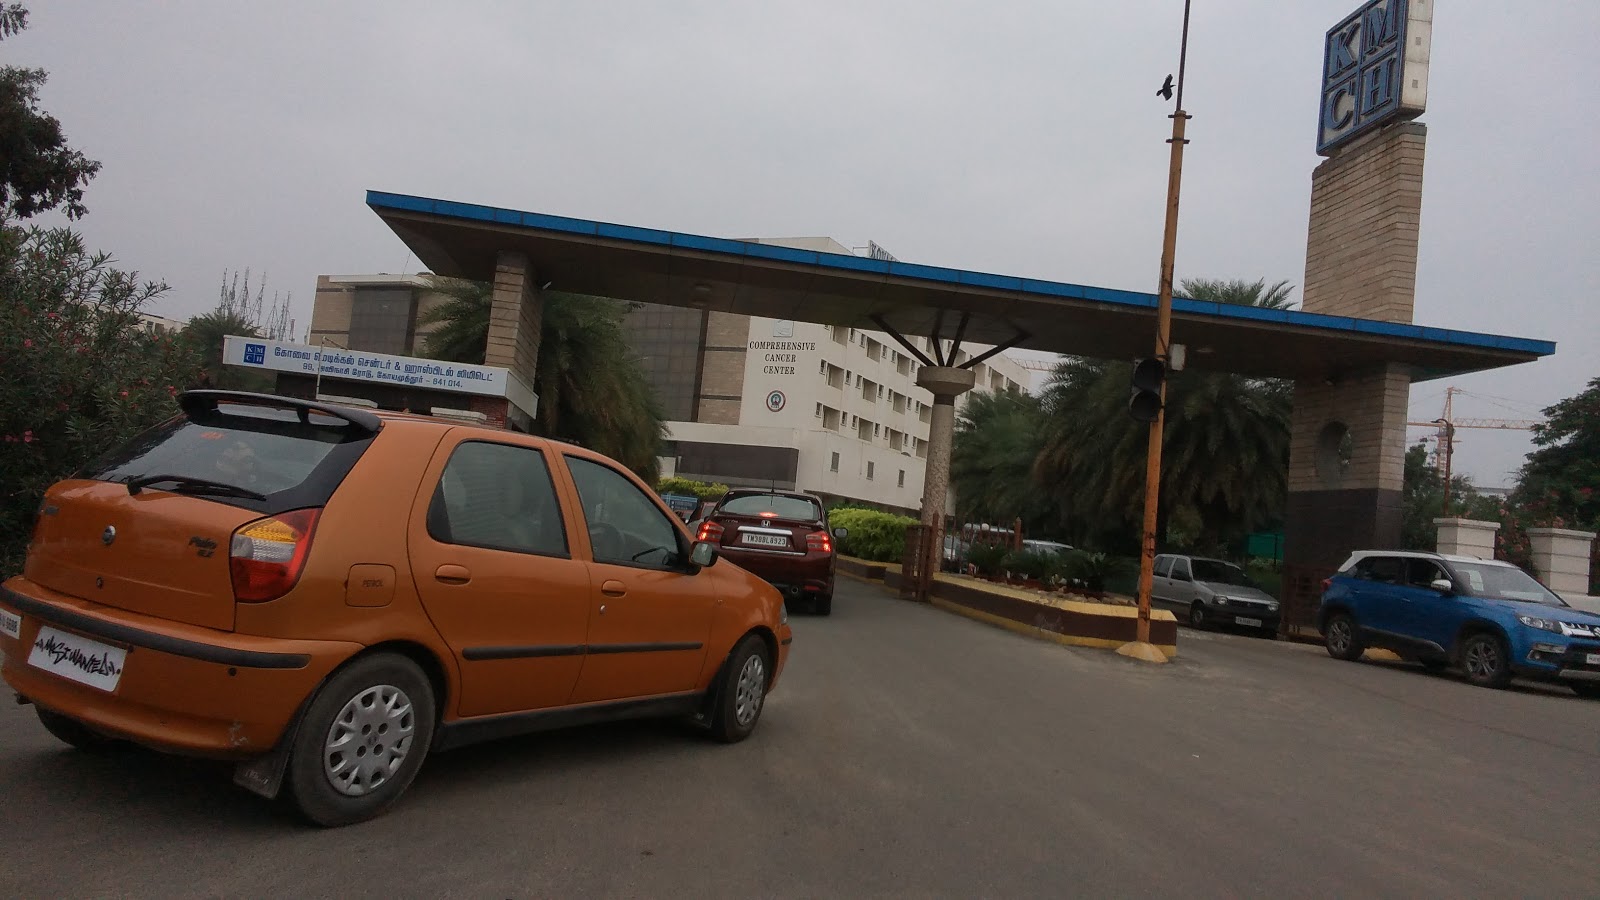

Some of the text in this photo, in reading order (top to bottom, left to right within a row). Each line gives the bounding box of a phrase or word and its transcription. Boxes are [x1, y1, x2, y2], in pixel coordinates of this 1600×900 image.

[749, 341, 816, 351] COMPREHENSIVE
[274, 346, 311, 360] கோவை
[358, 357, 391, 370] சென்டர்
[394, 361, 401, 371] &
[765, 353, 797, 363] CANCER
[763, 365, 796, 375] CENTER
